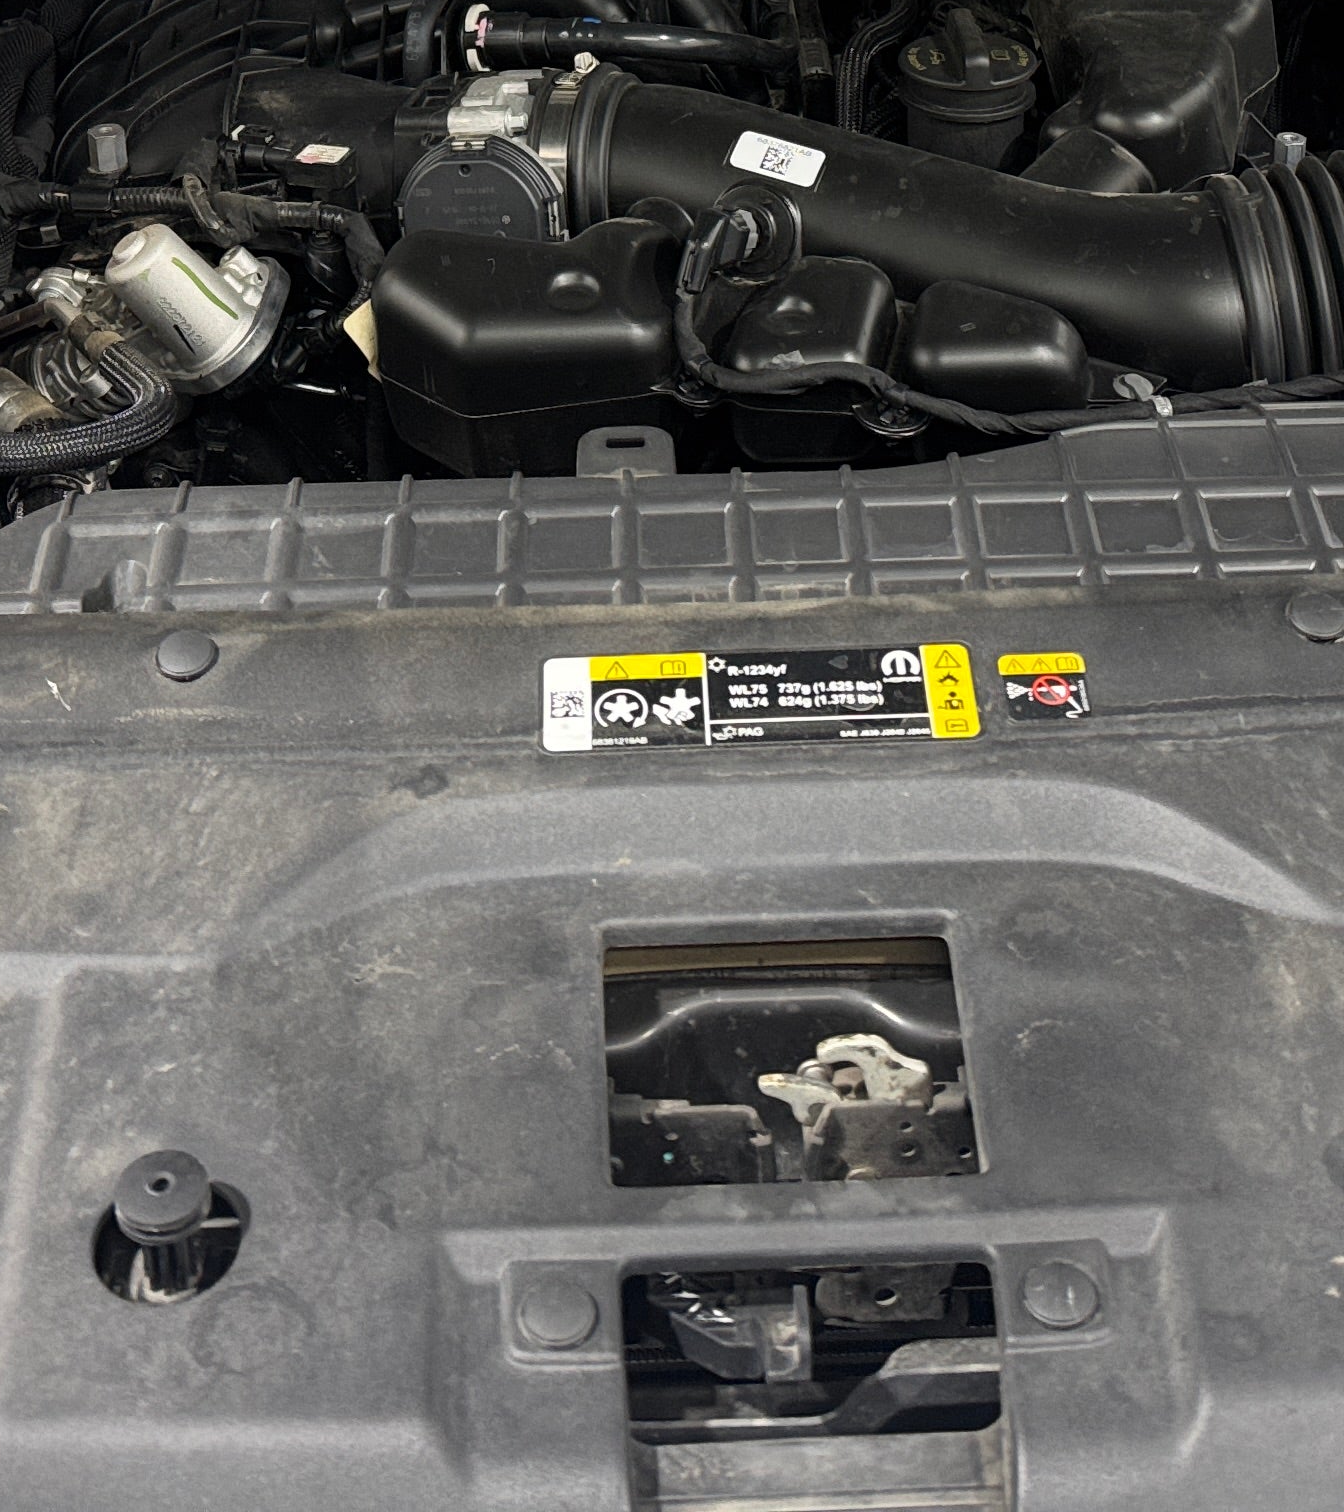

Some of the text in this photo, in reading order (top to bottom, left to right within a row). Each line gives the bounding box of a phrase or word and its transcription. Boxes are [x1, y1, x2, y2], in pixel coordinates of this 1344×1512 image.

[727, 664, 787, 677] R-1234yf
[728, 684, 768, 696] WL75
[729, 696, 769, 708] WL74
